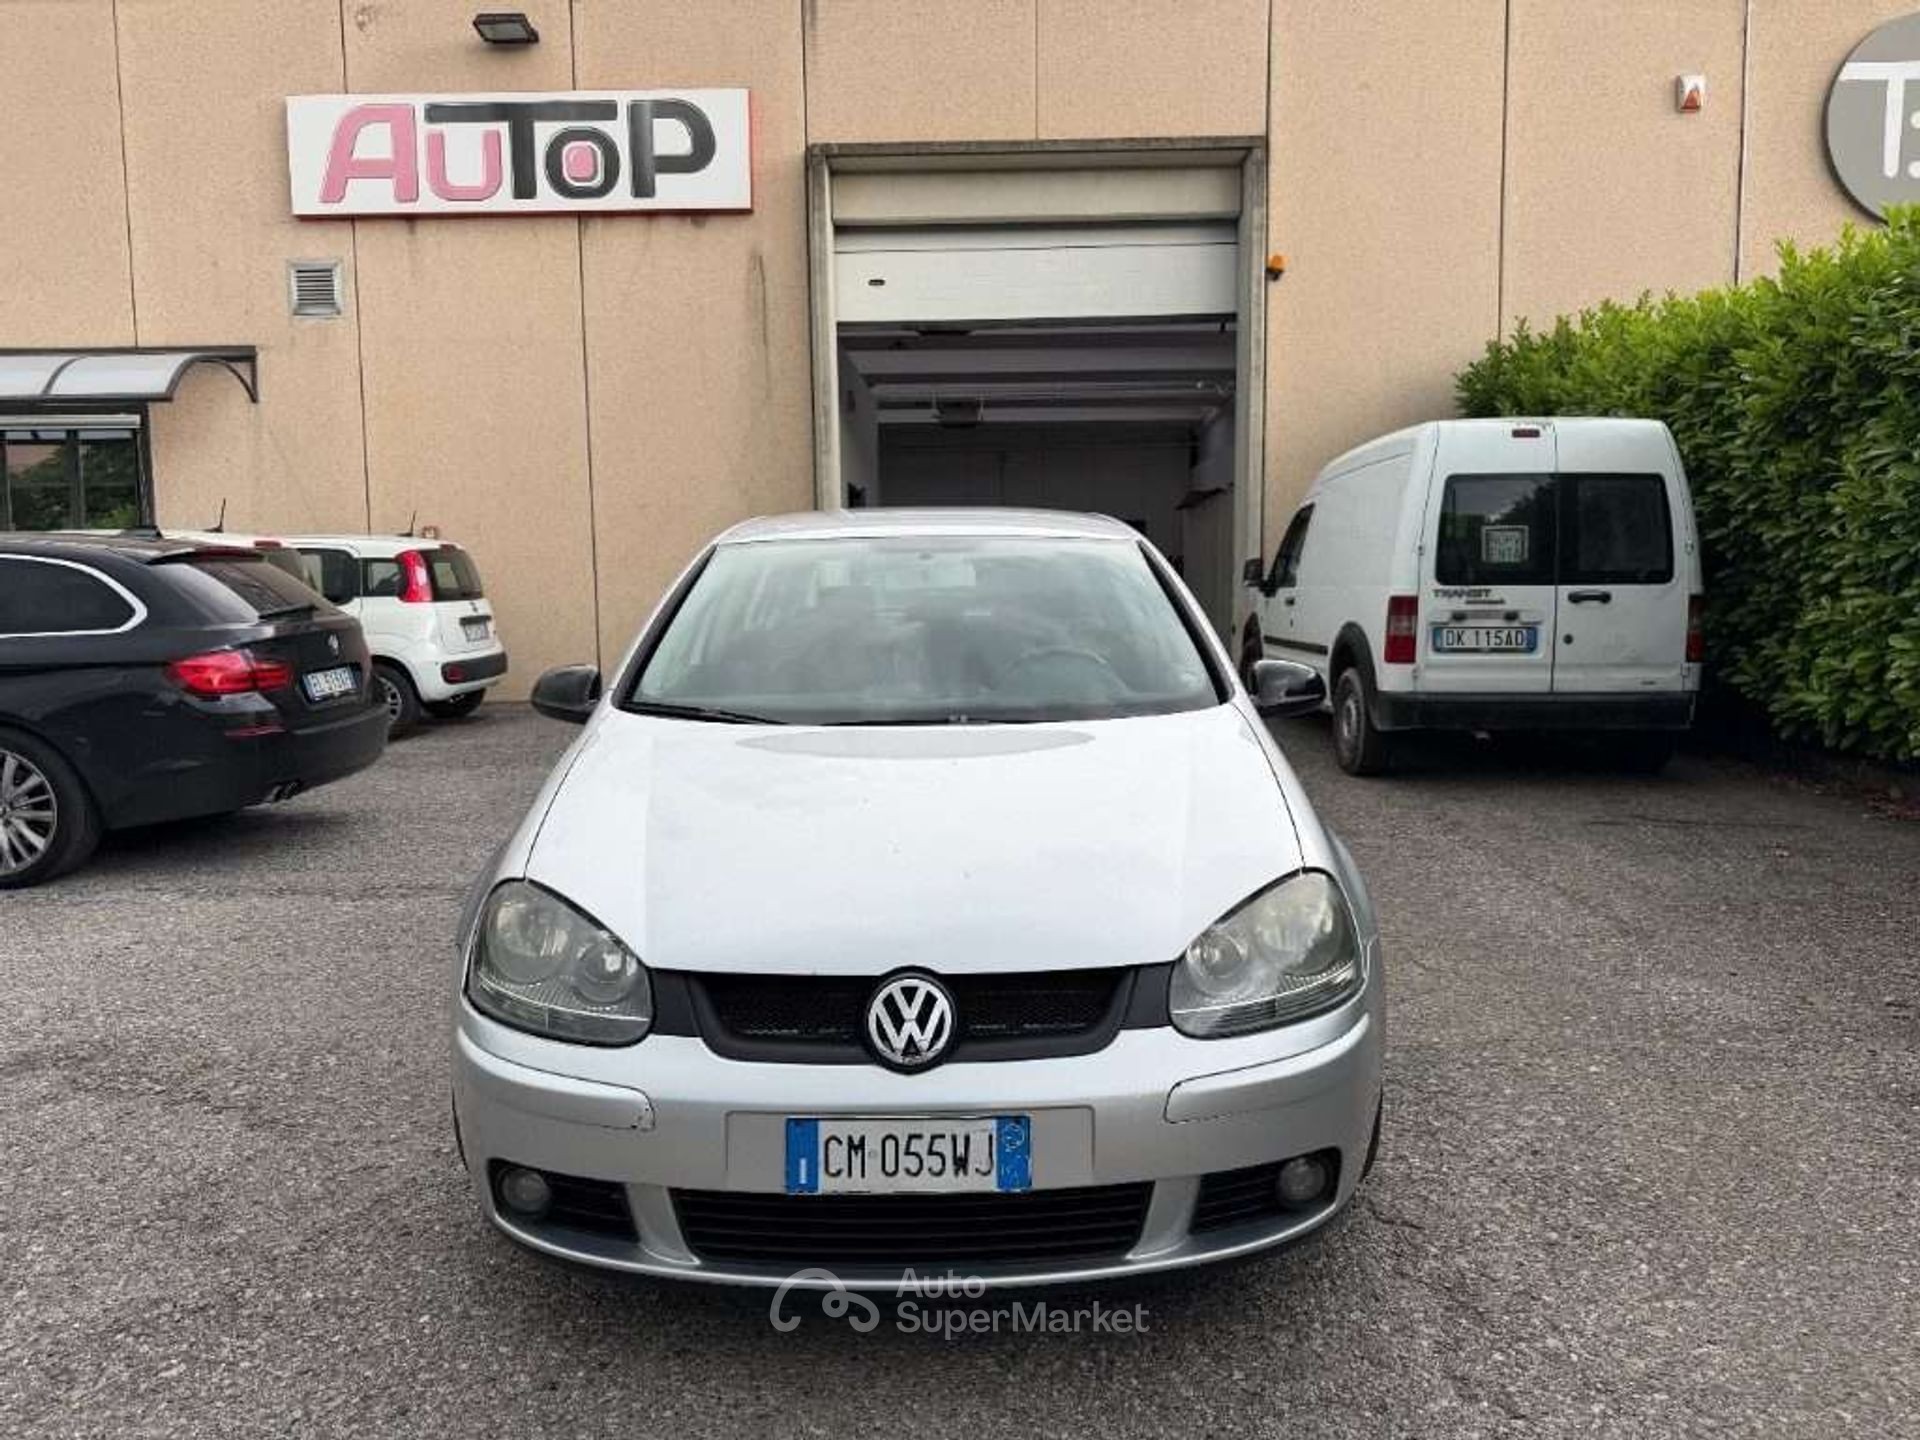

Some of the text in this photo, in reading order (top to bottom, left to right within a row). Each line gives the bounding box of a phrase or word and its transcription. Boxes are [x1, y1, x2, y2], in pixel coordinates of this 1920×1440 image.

[1446, 630, 1465, 646] DK
[823, 1134, 866, 1179] CM
[880, 1133, 994, 1178] 055WJ
